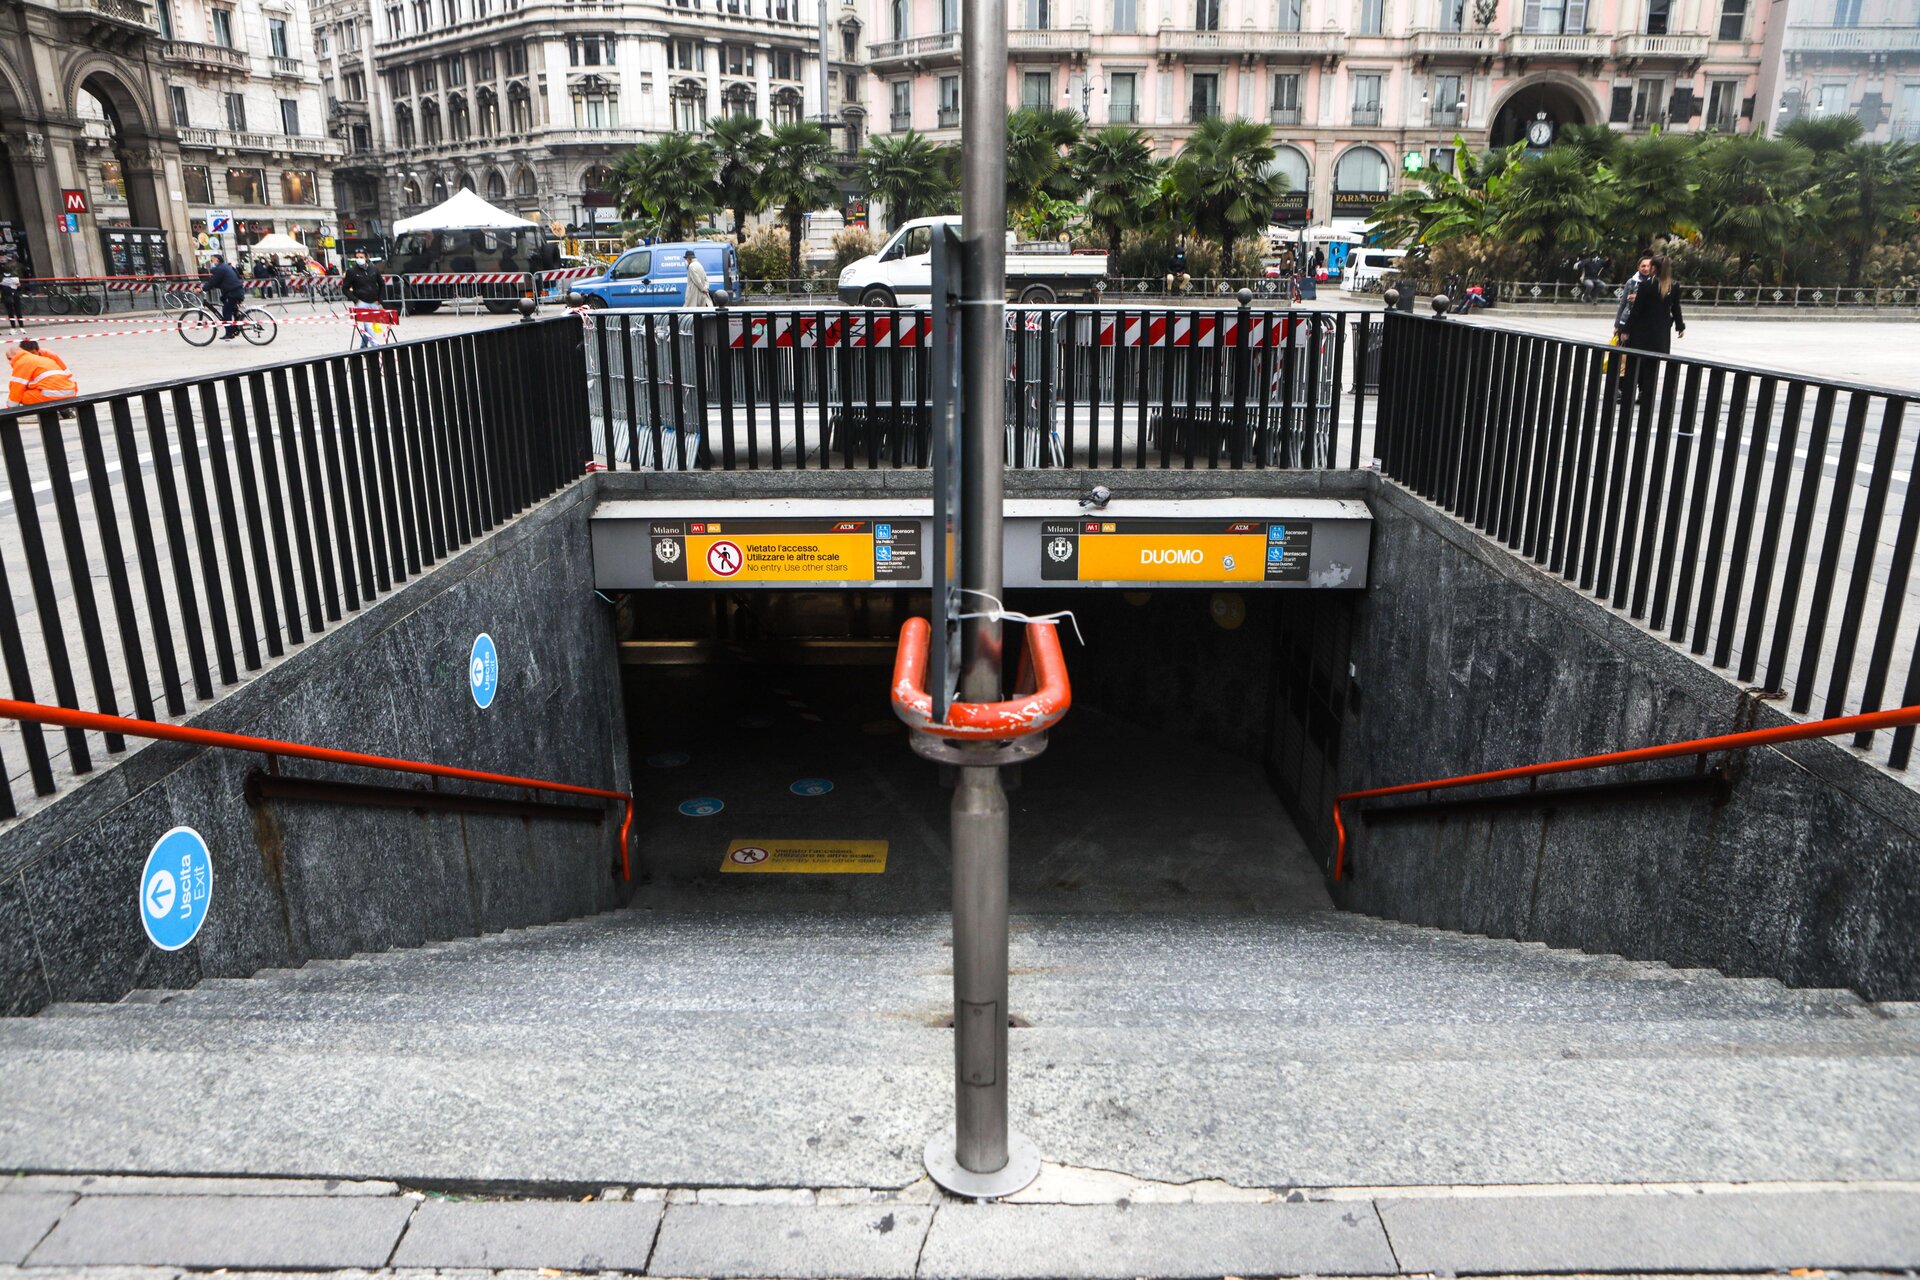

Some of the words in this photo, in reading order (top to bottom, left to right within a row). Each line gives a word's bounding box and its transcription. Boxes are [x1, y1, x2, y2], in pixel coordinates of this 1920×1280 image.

[67, 194, 85, 209] M
[1335, 194, 1386, 202] FARMACIA
[630, 284, 677, 293] POLIZIA
[1047, 525, 1074, 533] Milano
[746, 544, 776, 552] Vietato
[747, 553, 785, 561] Utilizzare
[787, 553, 794, 561] le
[796, 553, 815, 561] altre
[817, 553, 839, 561] scale
[1141, 549, 1204, 564] DUOMO
[802, 563, 824, 571] other
[826, 563, 848, 571] stairs
[194, 864, 205, 900] Exit
[180, 854, 192, 919] Uscita
